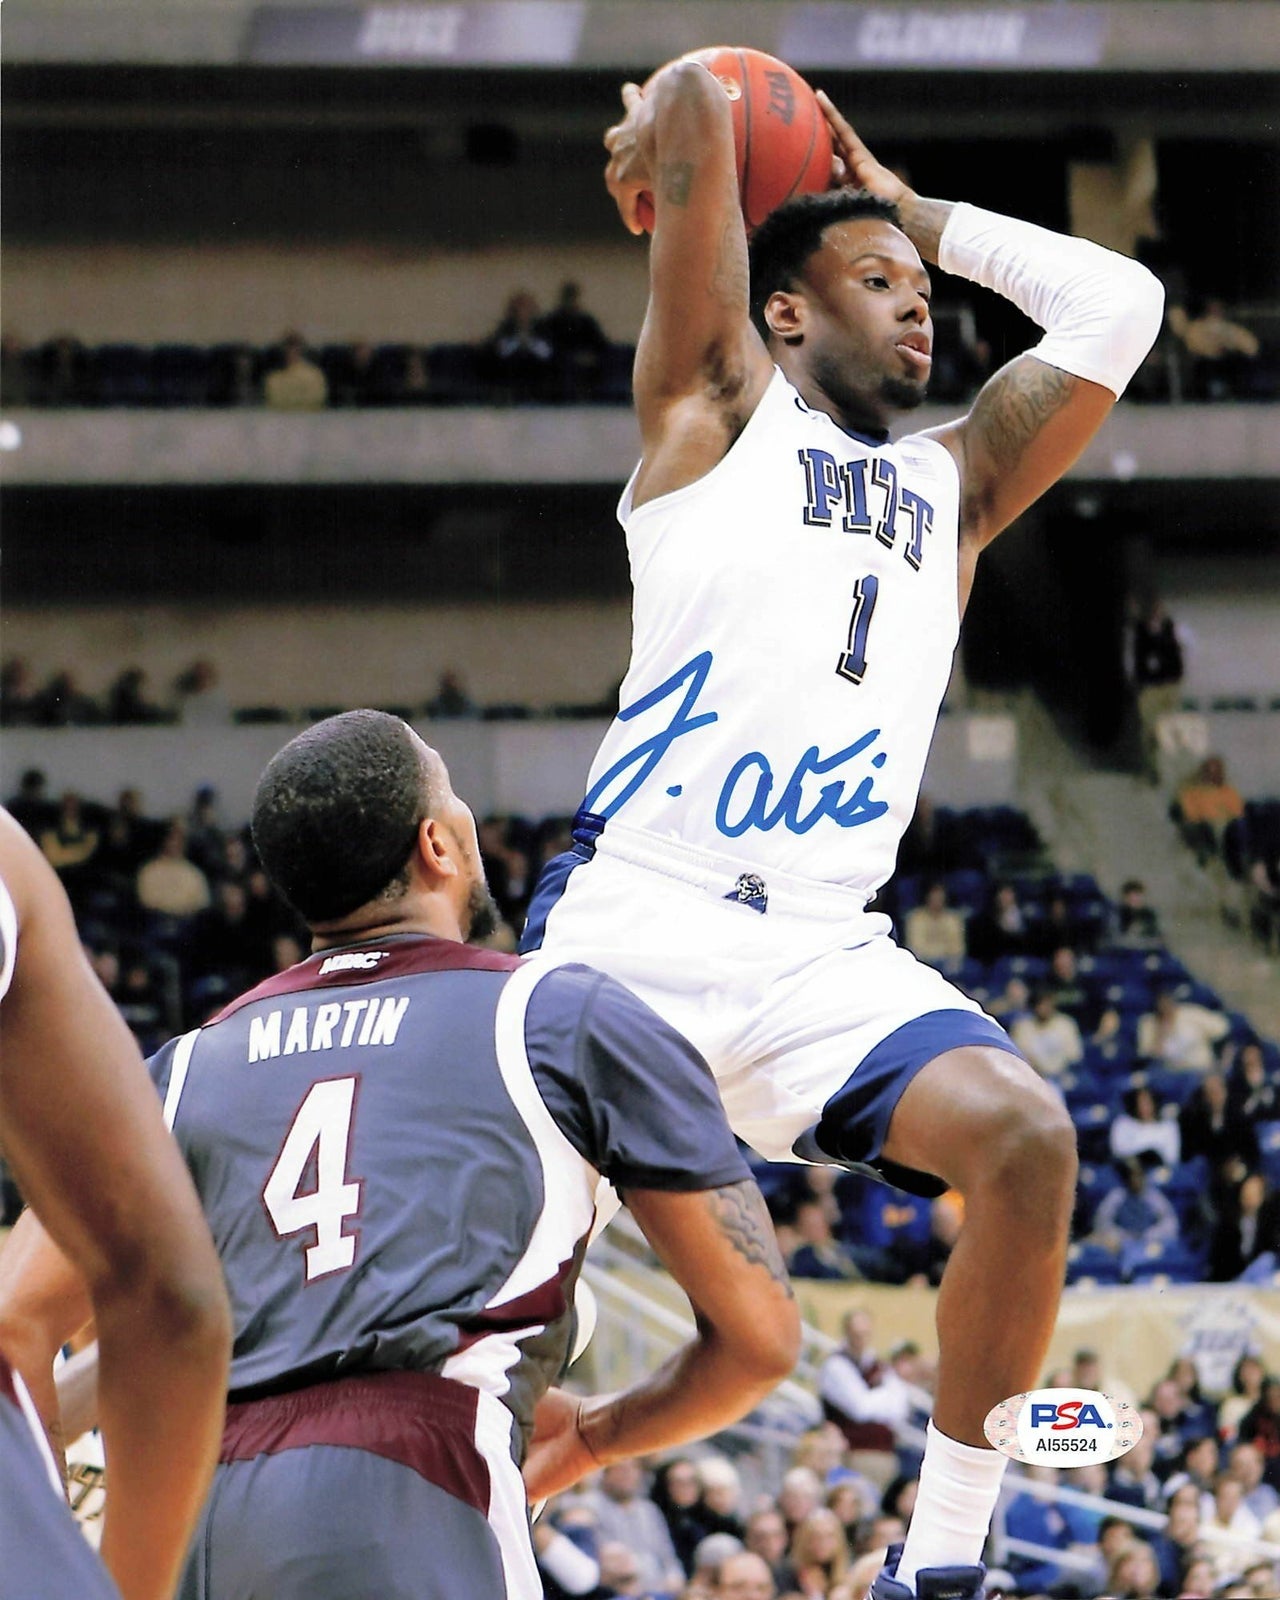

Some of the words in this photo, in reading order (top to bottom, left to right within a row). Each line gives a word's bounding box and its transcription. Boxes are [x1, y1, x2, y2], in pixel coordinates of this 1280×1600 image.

[798, 448, 934, 572] PITT
[835, 574, 878, 686] 1
[248, 997, 410, 1063] MARTIN
[261, 1073, 364, 1284] 4
